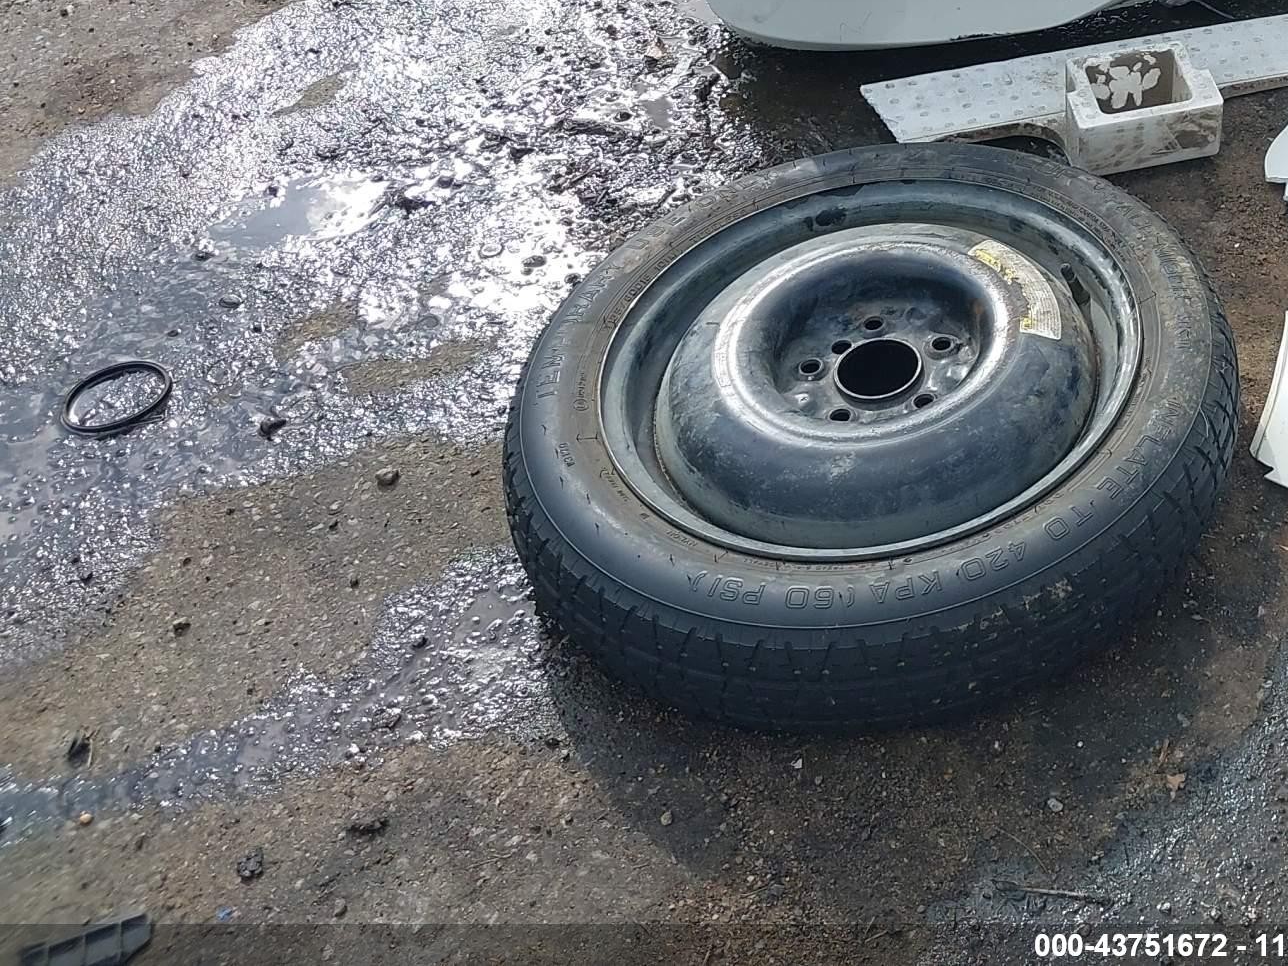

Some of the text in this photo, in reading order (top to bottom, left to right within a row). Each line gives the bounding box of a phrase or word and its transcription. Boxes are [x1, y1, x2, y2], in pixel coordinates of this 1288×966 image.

[1095, 395, 1183, 500] INFLATE
[1043, 504, 1094, 541] TO
[960, 540, 1028, 581] 420
[871, 570, 943, 605] KPA
